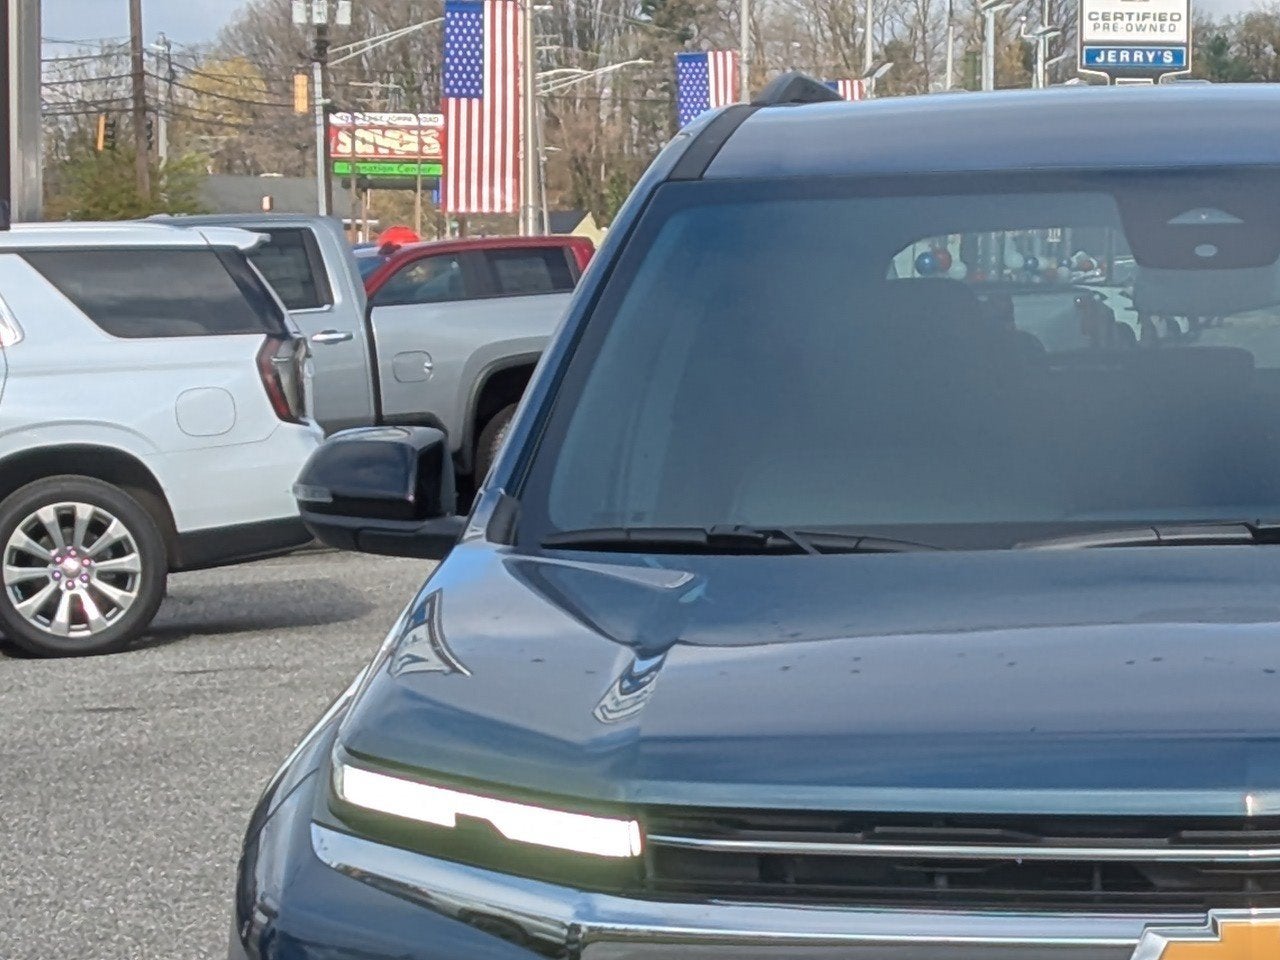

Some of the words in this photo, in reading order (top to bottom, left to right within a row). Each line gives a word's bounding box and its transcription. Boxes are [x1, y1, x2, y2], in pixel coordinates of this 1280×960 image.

[1088, 11, 1182, 21] CERTIFIED
[1093, 23, 1176, 33] PRE-OWNED
[1095, 50, 1174, 63] JERRY'S
